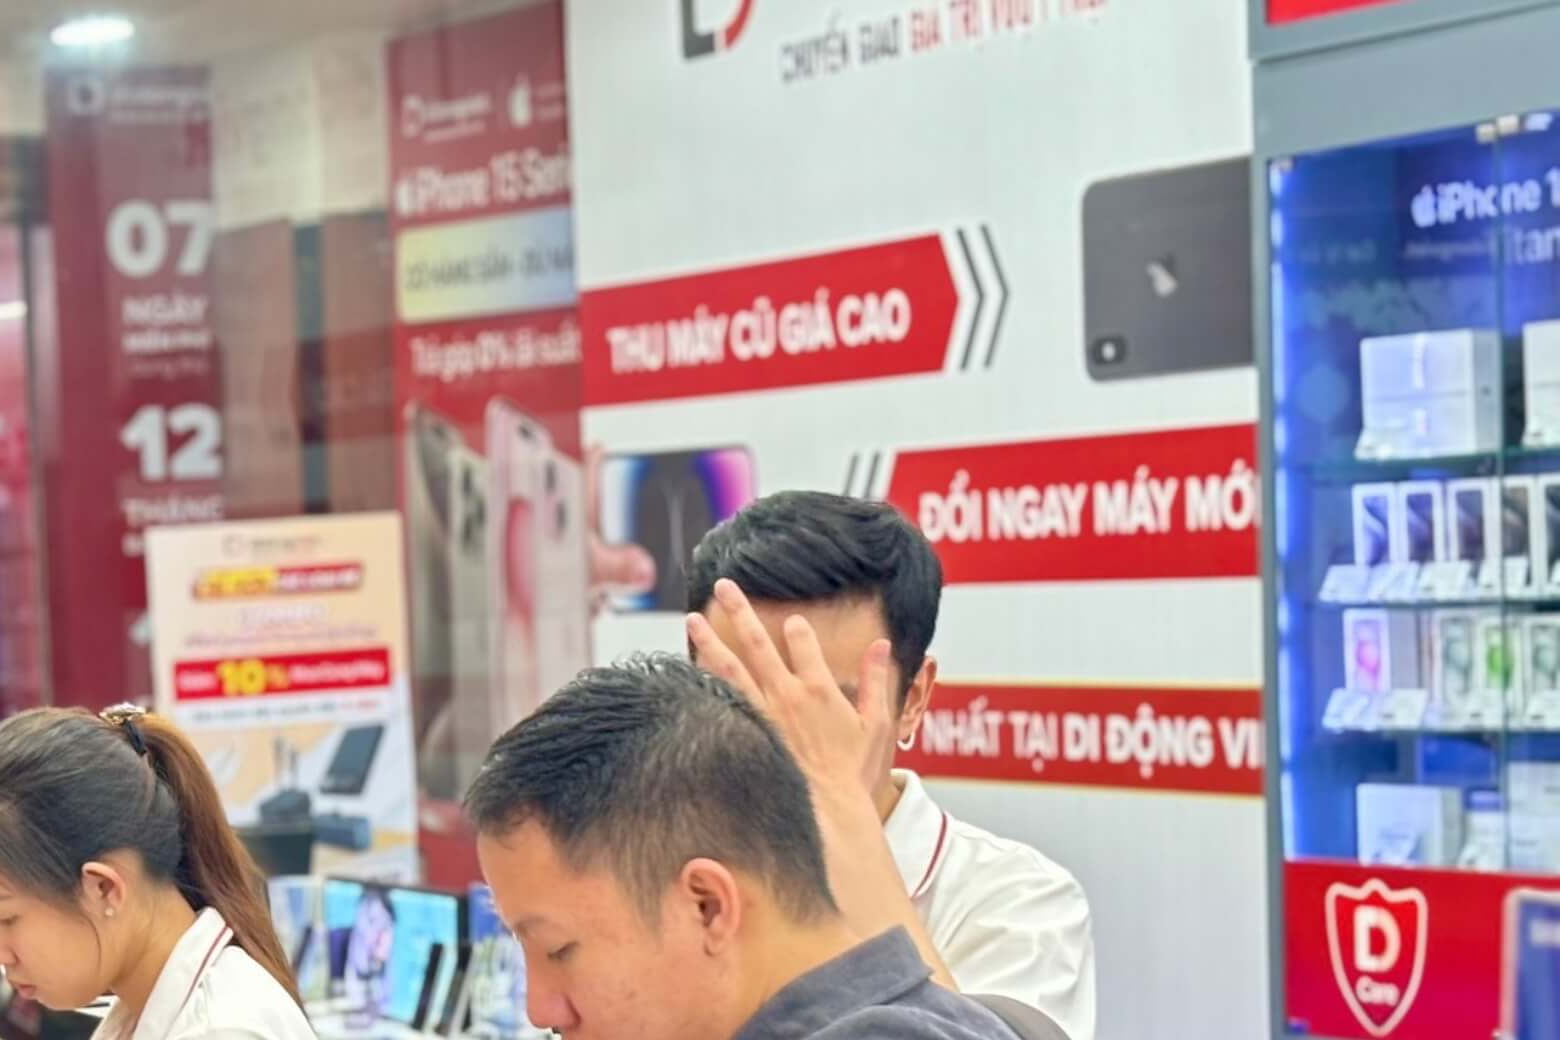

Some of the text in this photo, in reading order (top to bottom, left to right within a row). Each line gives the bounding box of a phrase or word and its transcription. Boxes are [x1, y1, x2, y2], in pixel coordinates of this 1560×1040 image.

[106, 200, 216, 277] 07
[605, 285, 912, 374] THU MÁY CŨ GIÁ CAO
[120, 402, 223, 481] 12
[918, 467, 982, 544] ĐỔI
[987, 480, 1089, 541] NGAY
[1092, 464, 1180, 537] MÁY
[922, 695, 1004, 759] NHẤT
[1007, 709, 1059, 774] TẠI
[1062, 712, 1101, 763] DI
[1104, 702, 1215, 780] ĐỘNG
[1354, 905, 1402, 973] D
